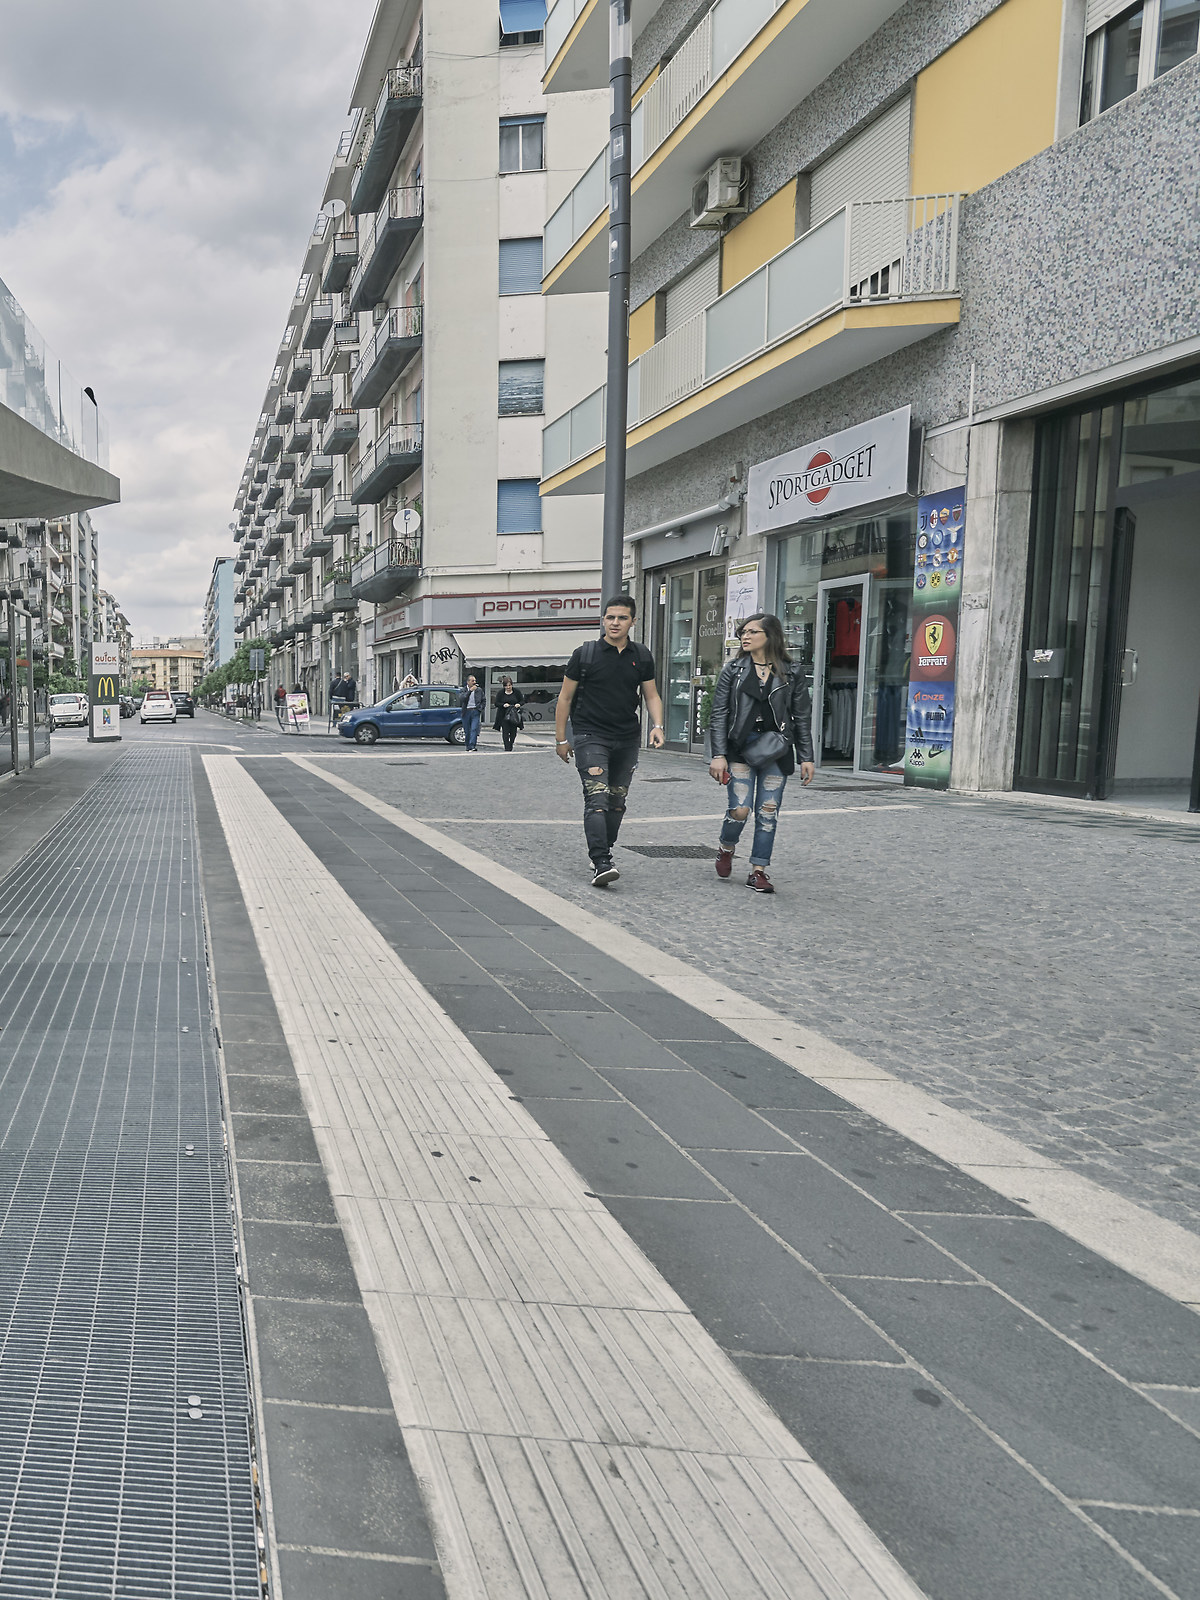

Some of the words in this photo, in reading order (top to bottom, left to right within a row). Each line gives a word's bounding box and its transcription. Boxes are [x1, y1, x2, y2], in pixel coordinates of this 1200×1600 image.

[767, 443, 877, 510] SPORTGADGET
[706, 609, 717, 623] CP
[918, 656, 948, 667] Ferrari
[926, 712, 944, 721] PUMA
[909, 758, 925, 767] Kappa
